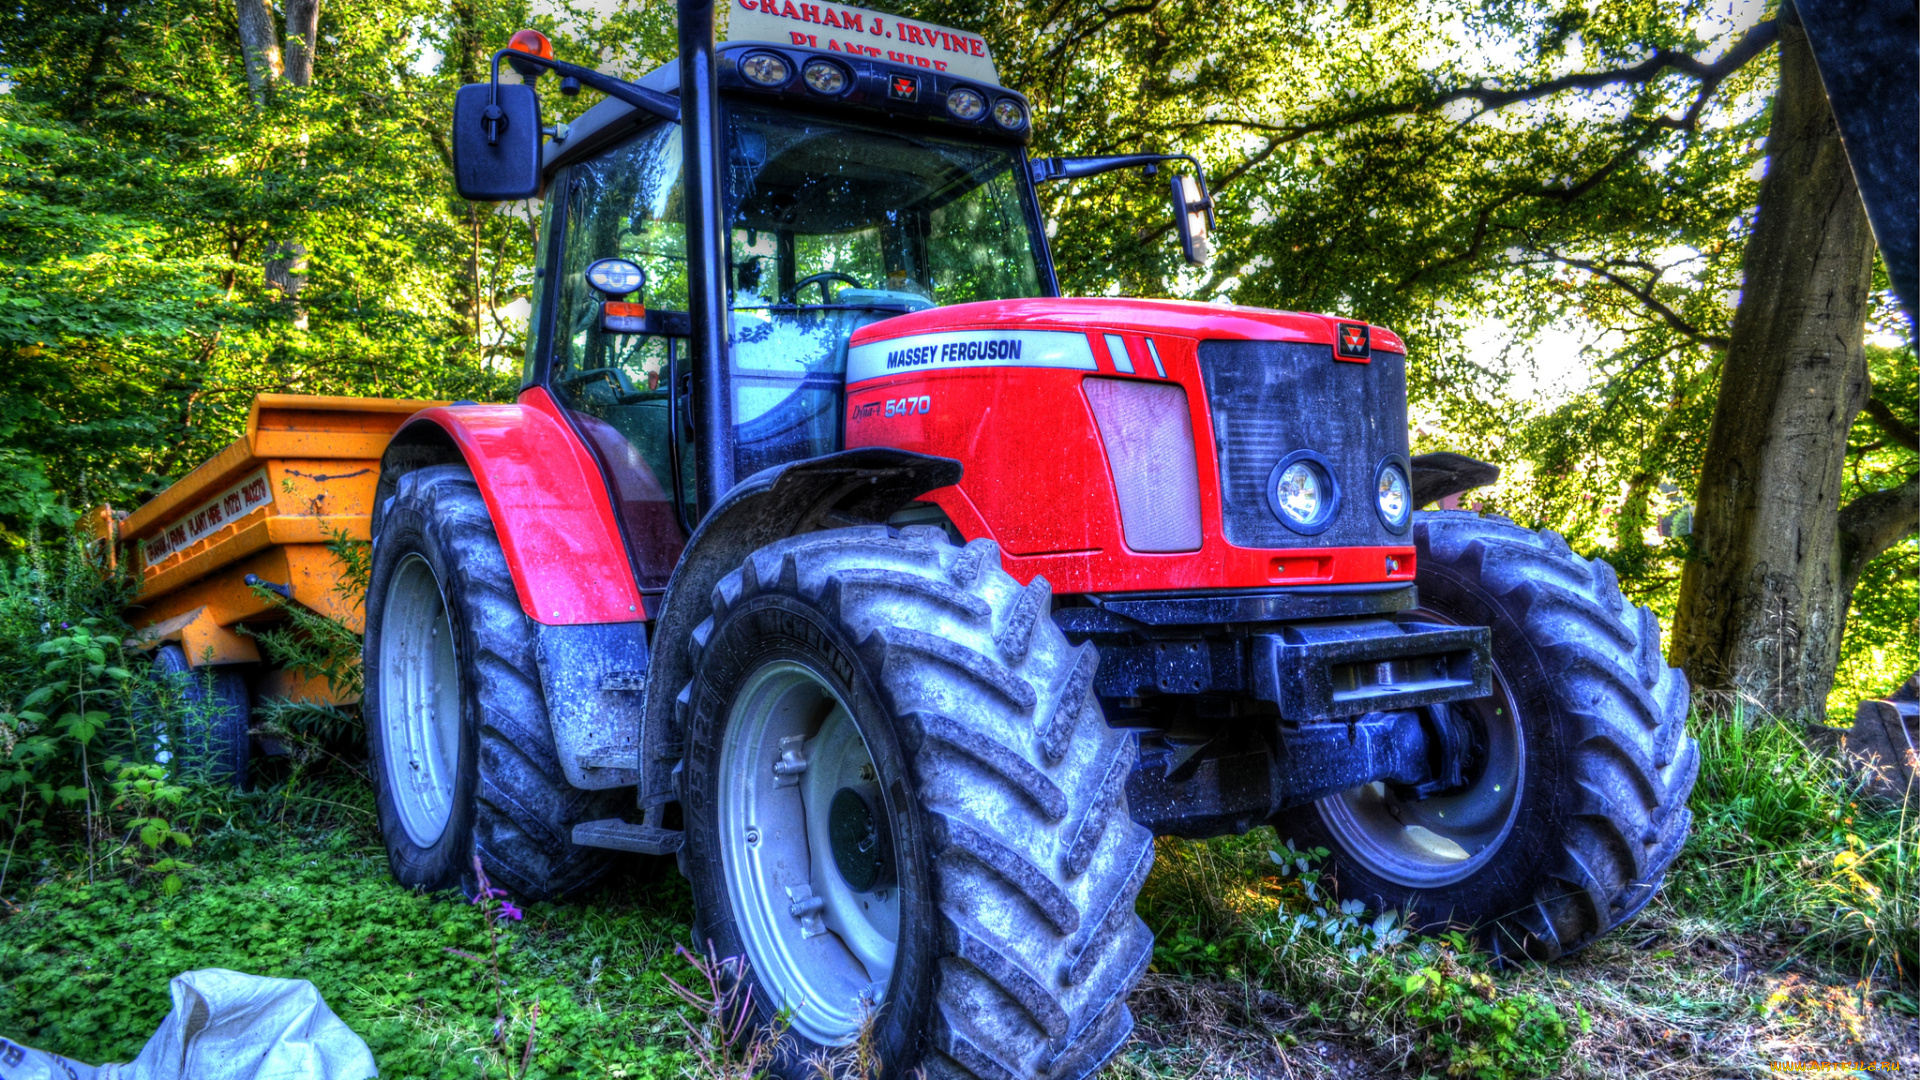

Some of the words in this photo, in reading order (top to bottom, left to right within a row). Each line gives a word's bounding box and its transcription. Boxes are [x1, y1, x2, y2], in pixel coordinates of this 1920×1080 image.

[738, 0, 864, 32] GRAHAM
[870, 17, 892, 38] J.
[897, 22, 985, 58] IRVINE
[887, 345, 938, 369] MASSEY
[941, 339, 1022, 362] FERGUSON
[884, 395, 931, 418] 5470
